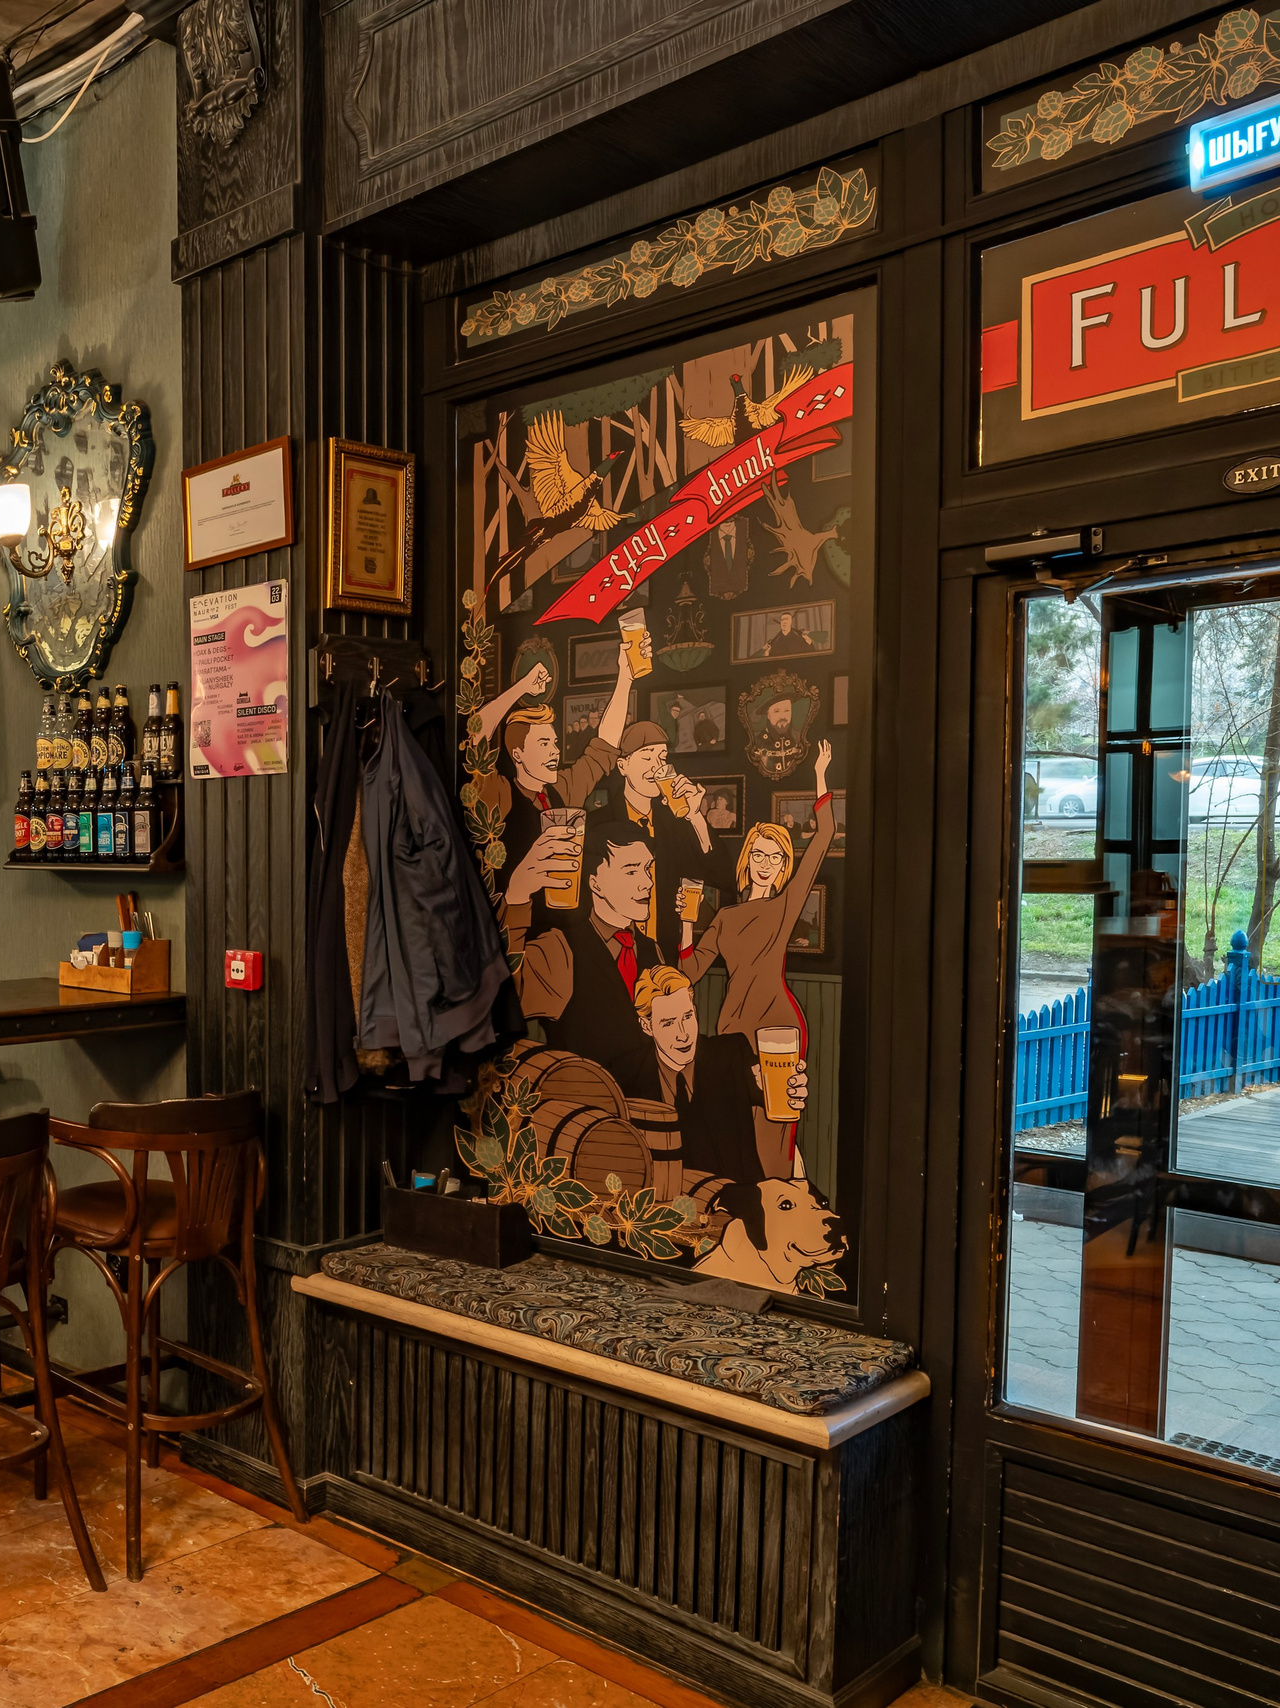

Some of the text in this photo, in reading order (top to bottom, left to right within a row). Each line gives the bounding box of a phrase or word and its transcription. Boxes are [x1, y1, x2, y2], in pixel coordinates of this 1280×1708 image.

[707, 436, 776, 506] drunk
[1233, 463, 1280, 485] EXIT
[608, 523, 668, 591] Stay
[271, 594, 280, 602] 03
[194, 632, 225, 645] MAIN STAGE
[213, 646, 227, 654] DEGS
[213, 654, 234, 663] POCKET
[237, 707, 257, 716] SILENT
[257, 705, 276, 714] DISCO
[143, 737, 159, 751] REW
